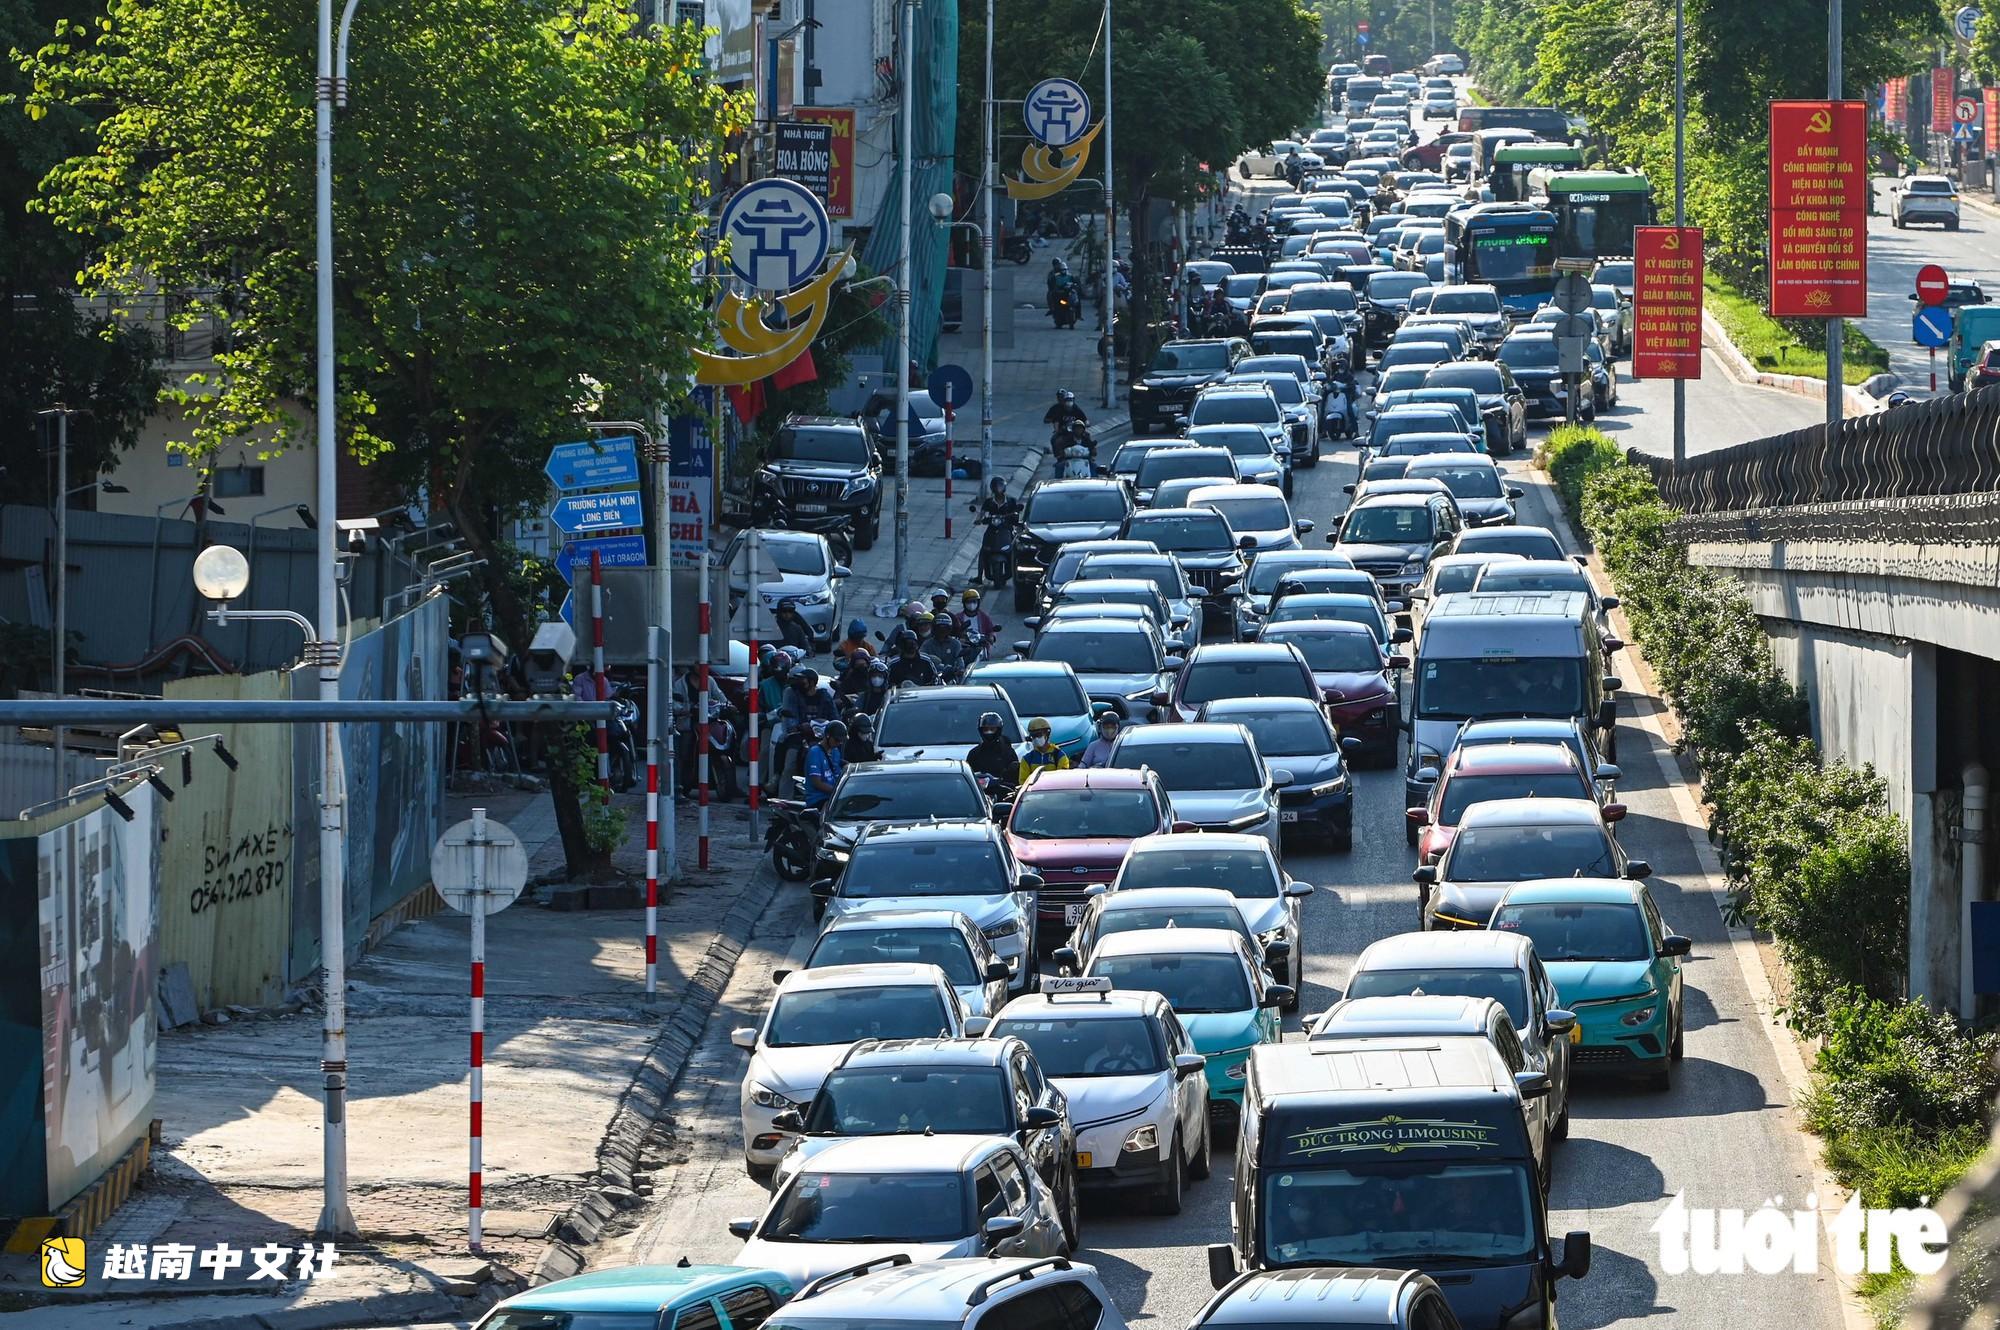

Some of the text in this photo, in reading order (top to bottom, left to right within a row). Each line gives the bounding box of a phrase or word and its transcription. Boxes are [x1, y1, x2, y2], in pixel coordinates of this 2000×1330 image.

[784, 128, 801, 139] NHÀ
[777, 150, 797, 171] HOA
[800, 141, 828, 172] HỒNG
[1815, 147, 1838, 158] MẠNH
[1783, 161, 1804, 173] CÔNG
[1806, 161, 1835, 174] NGHIỆP
[1792, 177, 1810, 190] HIỆN
[1813, 179, 1825, 190] ĐẠI
[1791, 193, 1846, 206] LẤY KHOA HỌC
[1796, 209, 1841, 223] CÔNG NGHỆ
[1798, 226, 1813, 237] MỚI
[1815, 226, 1837, 237] SÁNG
[1839, 228, 1853, 239] TẠO
[1783, 242, 1793, 253] VÀ
[1659, 258, 1693, 269] NGUYÊN
[1777, 258, 1859, 272] LÀM ĐỘNG LỰC CHÍNH
[1644, 274, 1666, 284] PHÁT
[1666, 291, 1695, 302] MẠNH,
[1640, 306, 1697, 318] THỊNH VƯỢNG
[1640, 320, 1696, 334] CỦA DÂN TỘC
[1646, 336, 1690, 349] VIỆT NAM!
[568, 497, 597, 510] TRƯỜNG
[620, 496, 636, 506] NON
[670, 491, 701, 513] HÀ
[582, 509, 620, 522] LONG BIÊN
[570, 554, 589, 566] CÔNG
[617, 553, 645, 563] DRAGON
[1300, 1128, 1487, 1148] ĐỨC TRỌNG LIMOUSINE
